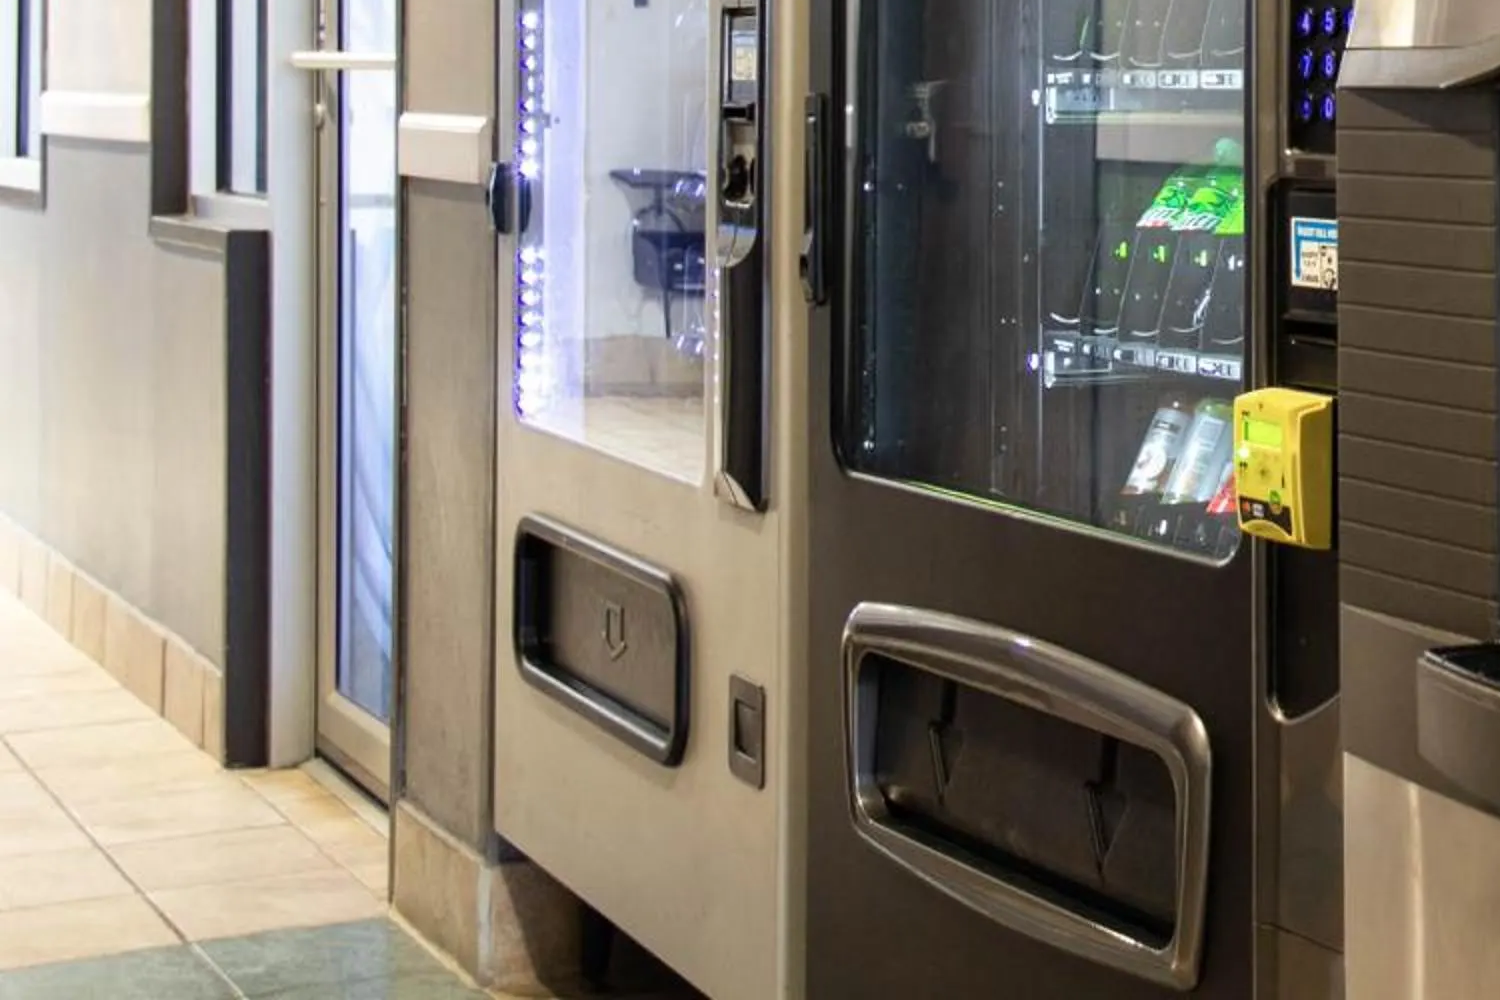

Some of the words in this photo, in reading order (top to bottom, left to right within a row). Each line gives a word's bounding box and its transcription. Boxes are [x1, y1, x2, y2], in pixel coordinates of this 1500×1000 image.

[1302, 13, 1310, 35] 4
[1324, 10, 1334, 33] 5
[1303, 55, 1311, 79] 7
[1325, 54, 1334, 76] 8
[1325, 95, 1334, 118] 0
